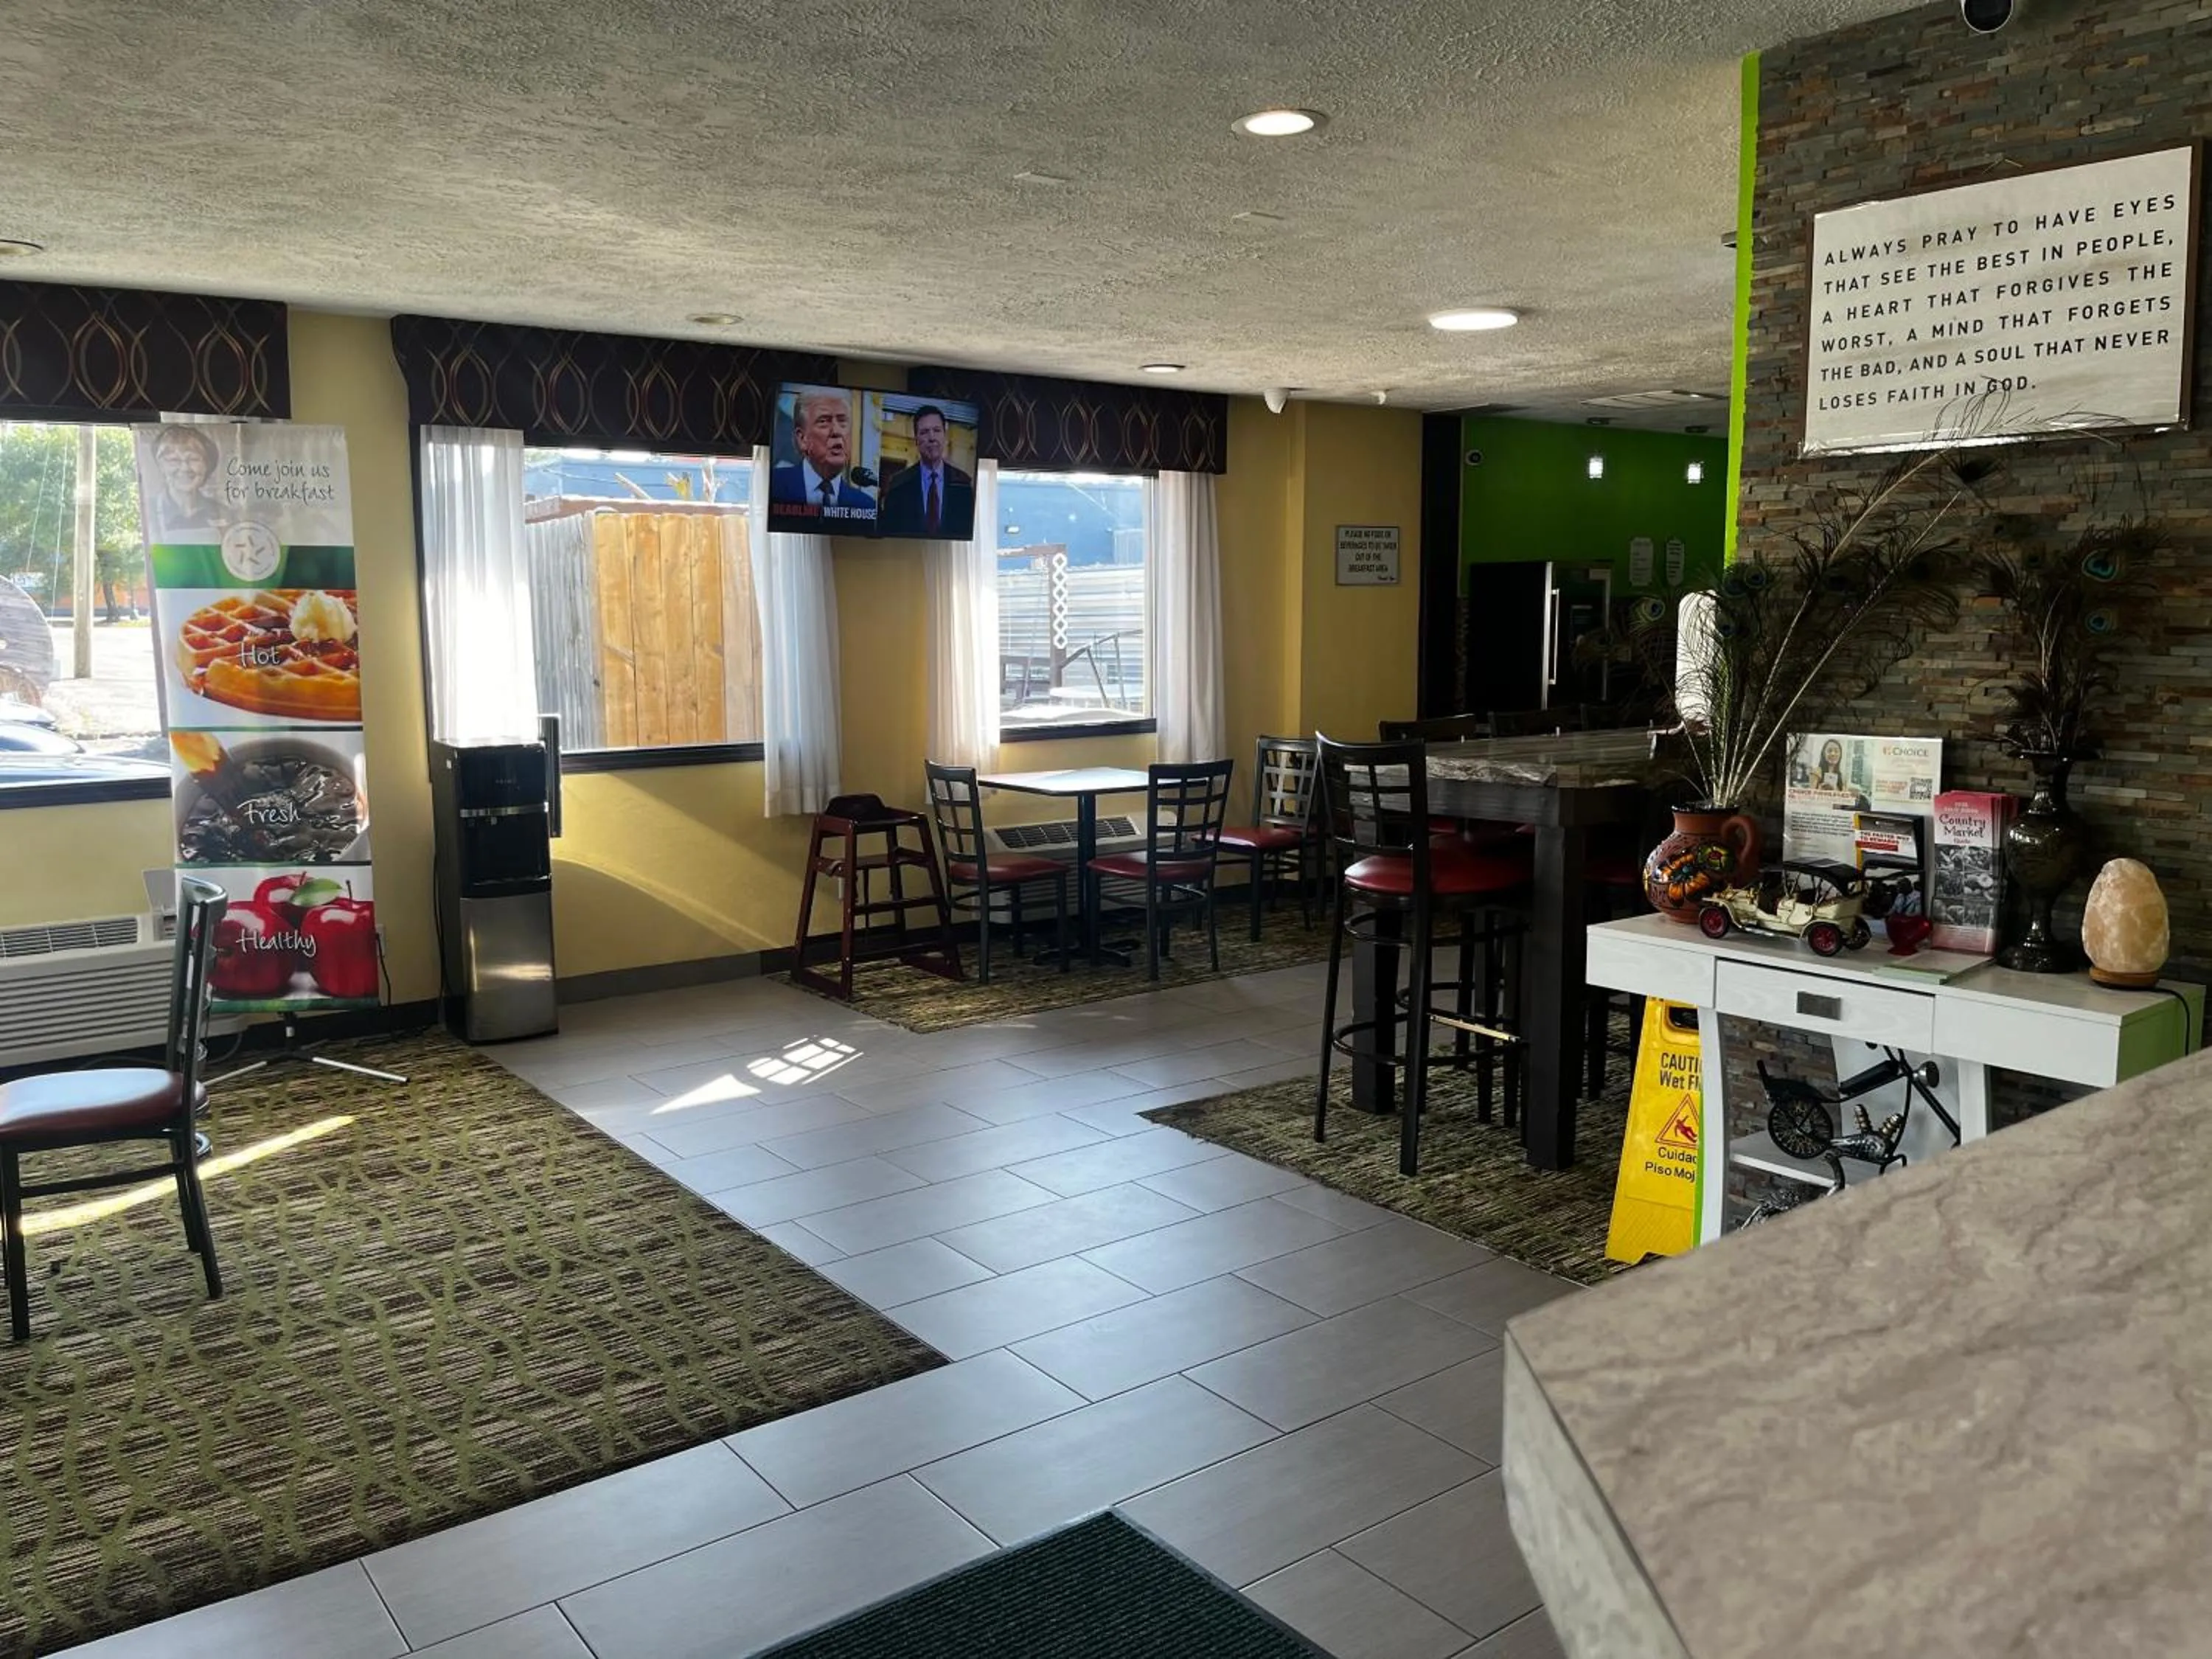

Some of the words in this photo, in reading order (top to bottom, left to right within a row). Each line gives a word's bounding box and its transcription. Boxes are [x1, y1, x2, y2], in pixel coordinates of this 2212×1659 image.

[1824, 239, 1907, 265] ALWAYS
[1921, 226, 1978, 249] PRAY
[1993, 220, 2019, 237] TO
[2035, 207, 2096, 230] HAVE
[2113, 194, 2175, 217] EYES
[1823, 276, 1871, 294] THAT
[1880, 268, 1916, 285] SEE
[1927, 260, 1965, 278] THE
[1977, 251, 2030, 271] BEST
[2042, 245, 2063, 261] IN
[2076, 230, 2174, 255] PEOPLE,
[1822, 310, 1832, 324] A
[1847, 299, 1913, 320] HEART
[1927, 288, 1980, 308] THAT
[1997, 271, 2110, 299] FORGIVES
[2128, 262, 2172, 282] THE
[1821, 332, 1893, 352] WORST,
[1906, 328, 1917, 341] A
[1932, 319, 1983, 338] MIND
[1999, 310, 2052, 330] THAT
[2067, 296, 2171, 321] FORGETS
[1820, 366, 1853, 381] THE
[1860, 361, 1902, 377] BAD,
[1909, 355, 1947, 371] AND
[1955, 352, 1966, 366] A
[1974, 346, 2025, 364] SOUL
[2034, 338, 2084, 357] THAT
[2095, 330, 2170, 350] NEVER
[1819, 393, 1877, 411] LOSES
[1887, 385, 1945, 403] FAITH
[1955, 381, 1976, 396] IN
[1986, 377, 2036, 393] GOD.
[226, 458, 271, 477] Come
[274, 459, 305, 483] join
[311, 464, 330, 479] us
[224, 480, 249, 504] for
[255, 481, 334, 506] breakfast
[823, 507, 849, 518] WHITE
[850, 507, 877, 520] HOUSE
[236, 642, 280, 668] Hot
[1893, 746, 1929, 757] CHOICE
[237, 799, 301, 824] Fresh
[1939, 813, 1986, 829] Country
[1944, 825, 1984, 838] Market
[235, 928, 316, 957] Healthy
[1660, 1070, 1685, 1090] Wet
[1645, 1161, 1672, 1176] Piso
